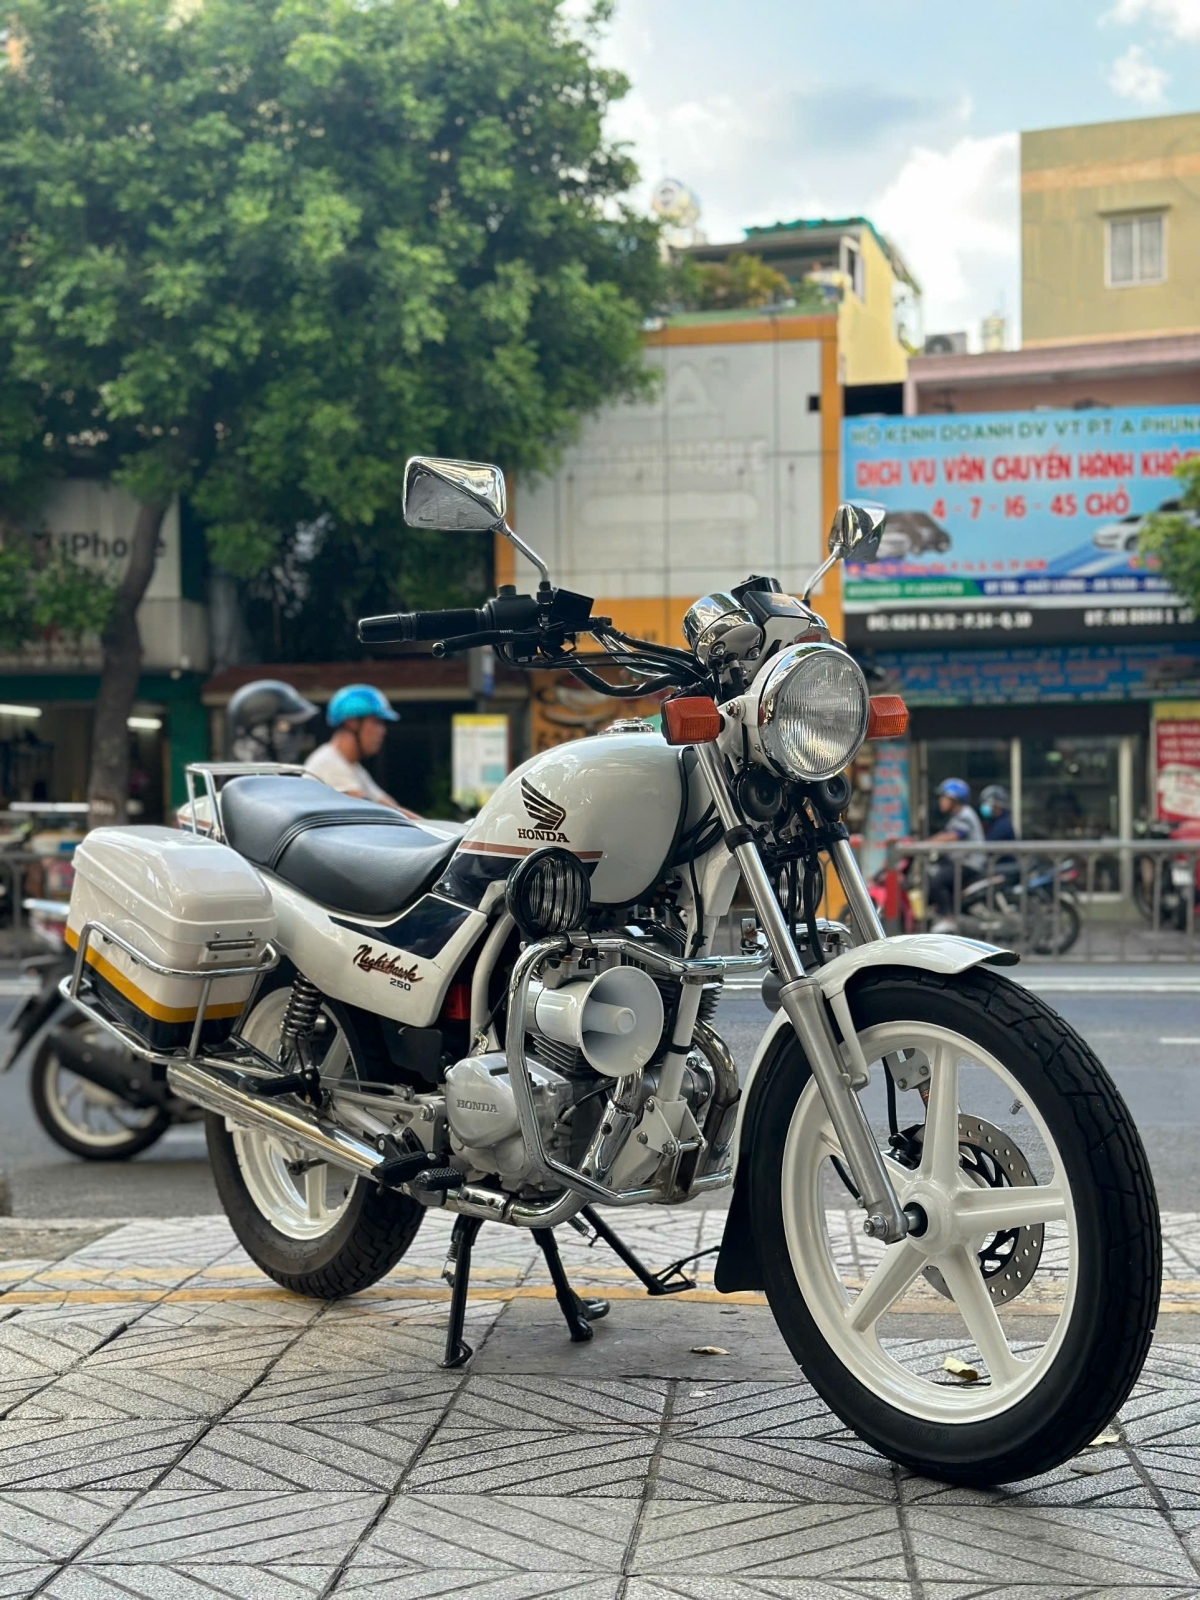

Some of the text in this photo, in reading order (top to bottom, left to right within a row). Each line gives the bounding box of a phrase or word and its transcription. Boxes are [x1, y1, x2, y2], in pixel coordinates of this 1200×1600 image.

[940, 422, 1013, 442] DOANH
[1018, 420, 1047, 438] DV
[1054, 419, 1081, 437] VT
[1087, 418, 1113, 435] PT
[1120, 417, 1136, 434] A
[856, 459, 902, 493] DỊCH
[908, 458, 936, 491] VỤ
[931, 497, 947, 520] 4
[969, 496, 982, 520] 7
[1005, 495, 1026, 519] 16
[1050, 493, 1077, 517] 45
[517, 828, 570, 843] HONDA
[353, 944, 424, 983] Nighthawk
[390, 977, 411, 991] 250
[457, 1099, 499, 1113] HONDA
